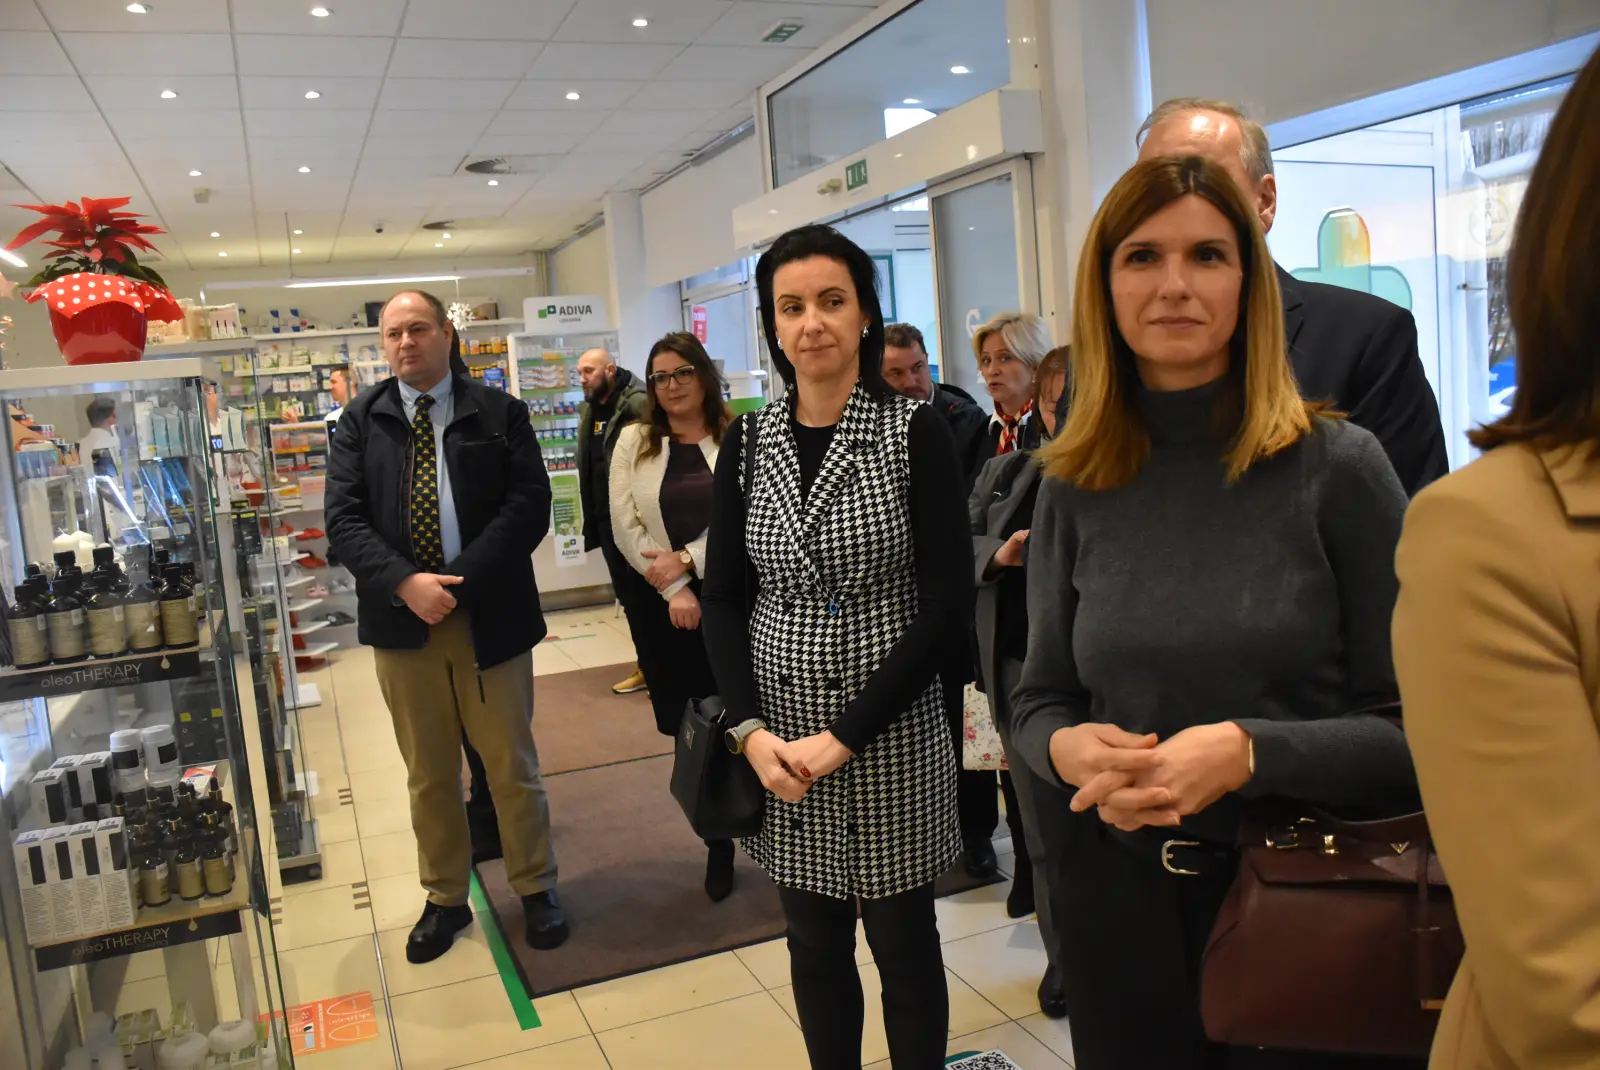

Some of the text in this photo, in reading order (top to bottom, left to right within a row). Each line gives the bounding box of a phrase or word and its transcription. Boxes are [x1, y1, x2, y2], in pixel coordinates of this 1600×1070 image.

[559, 304, 593, 316] ADIVA
[40, 662, 143, 688] oleoTHERAPY
[72, 926, 171, 957] oleoTHERAPY
